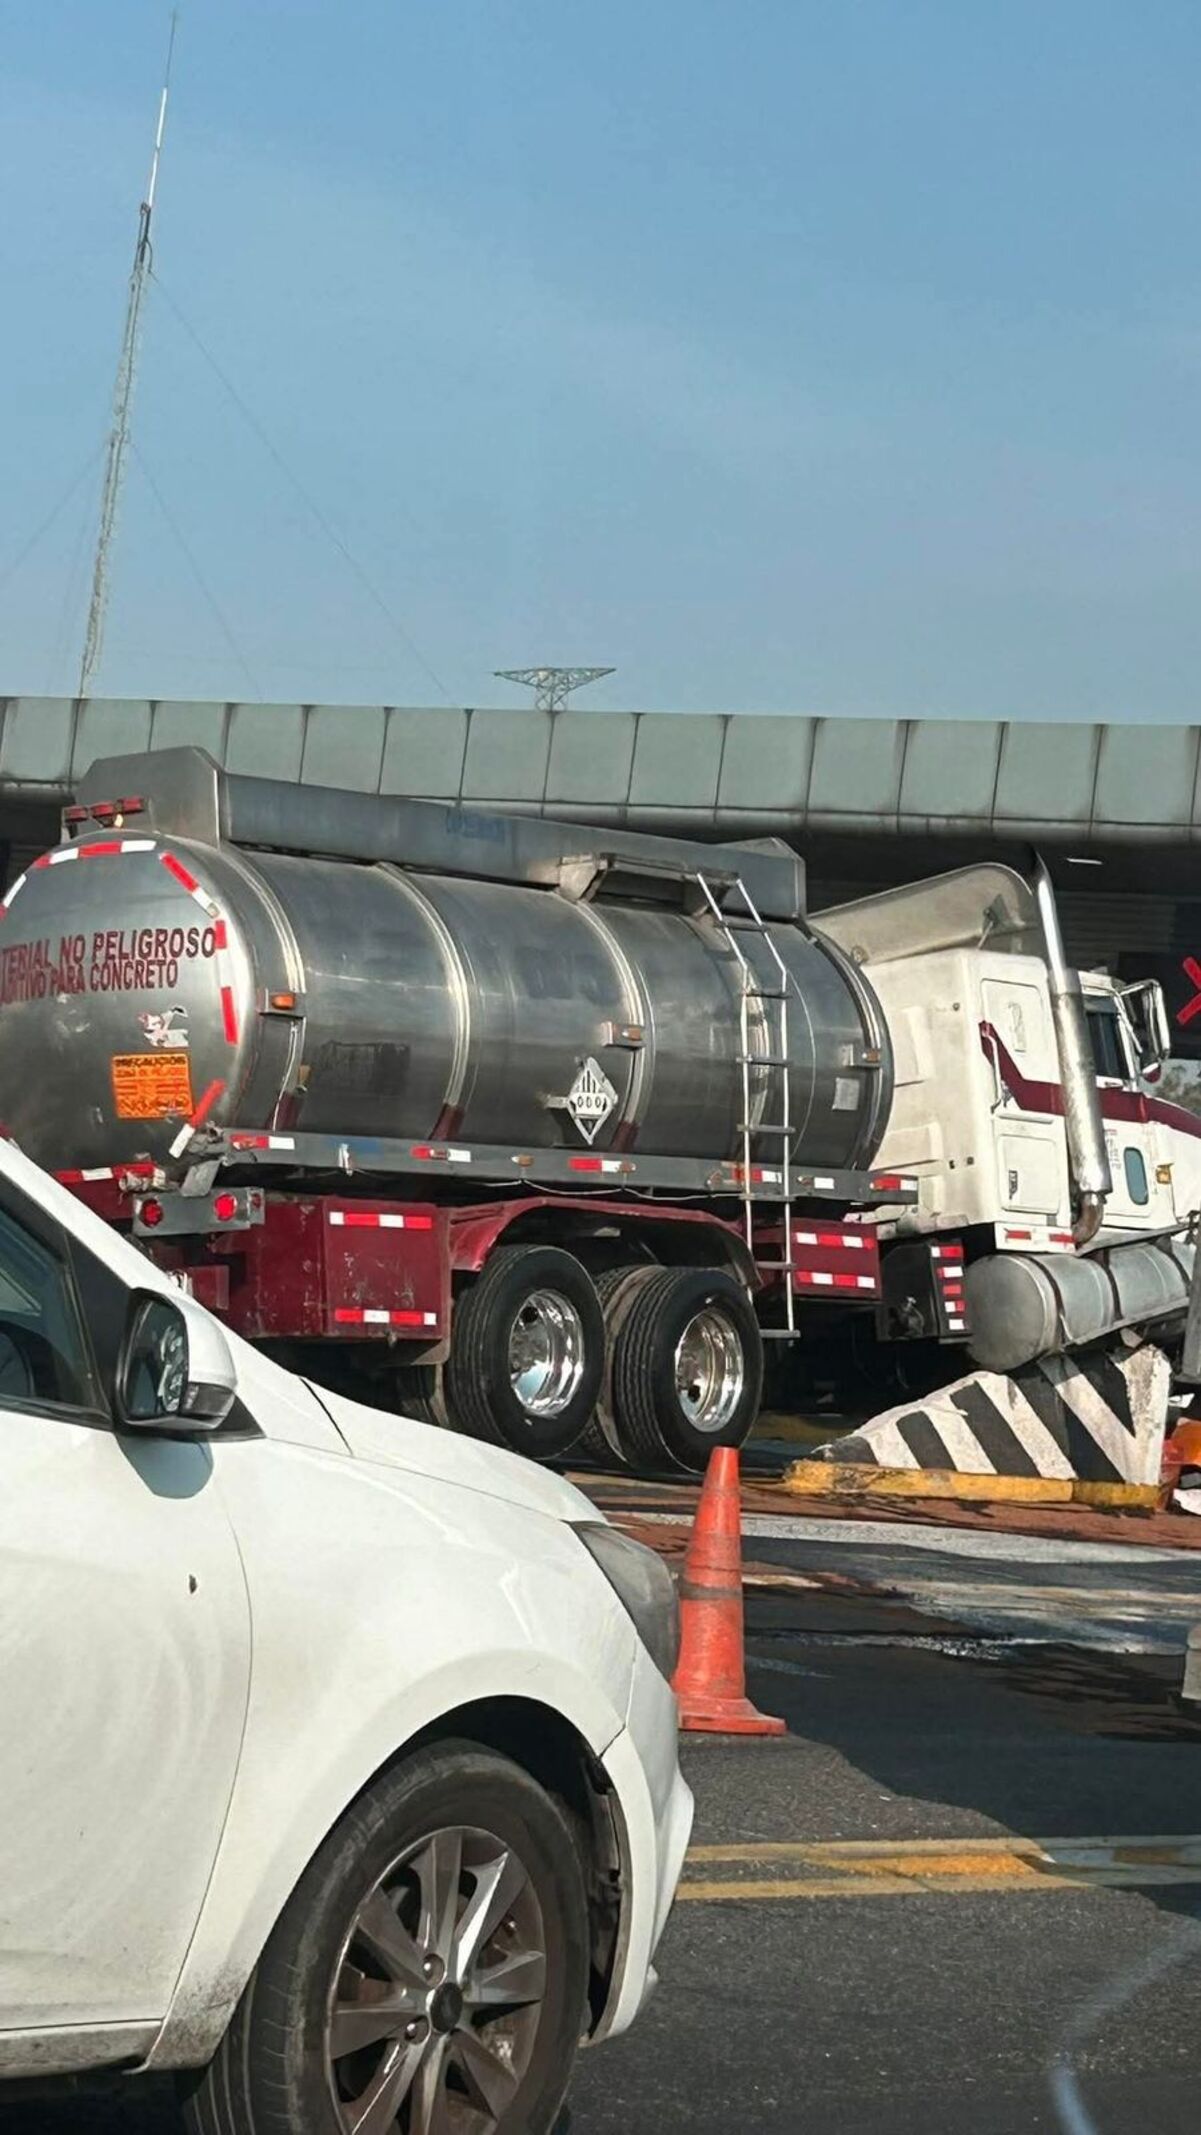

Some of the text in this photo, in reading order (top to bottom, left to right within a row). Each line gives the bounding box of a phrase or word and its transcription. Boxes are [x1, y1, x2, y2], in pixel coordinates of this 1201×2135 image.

[60, 934, 85, 963] NO
[92, 927, 216, 962] PELIGROSO
[90, 959, 178, 991] CONCRETO
